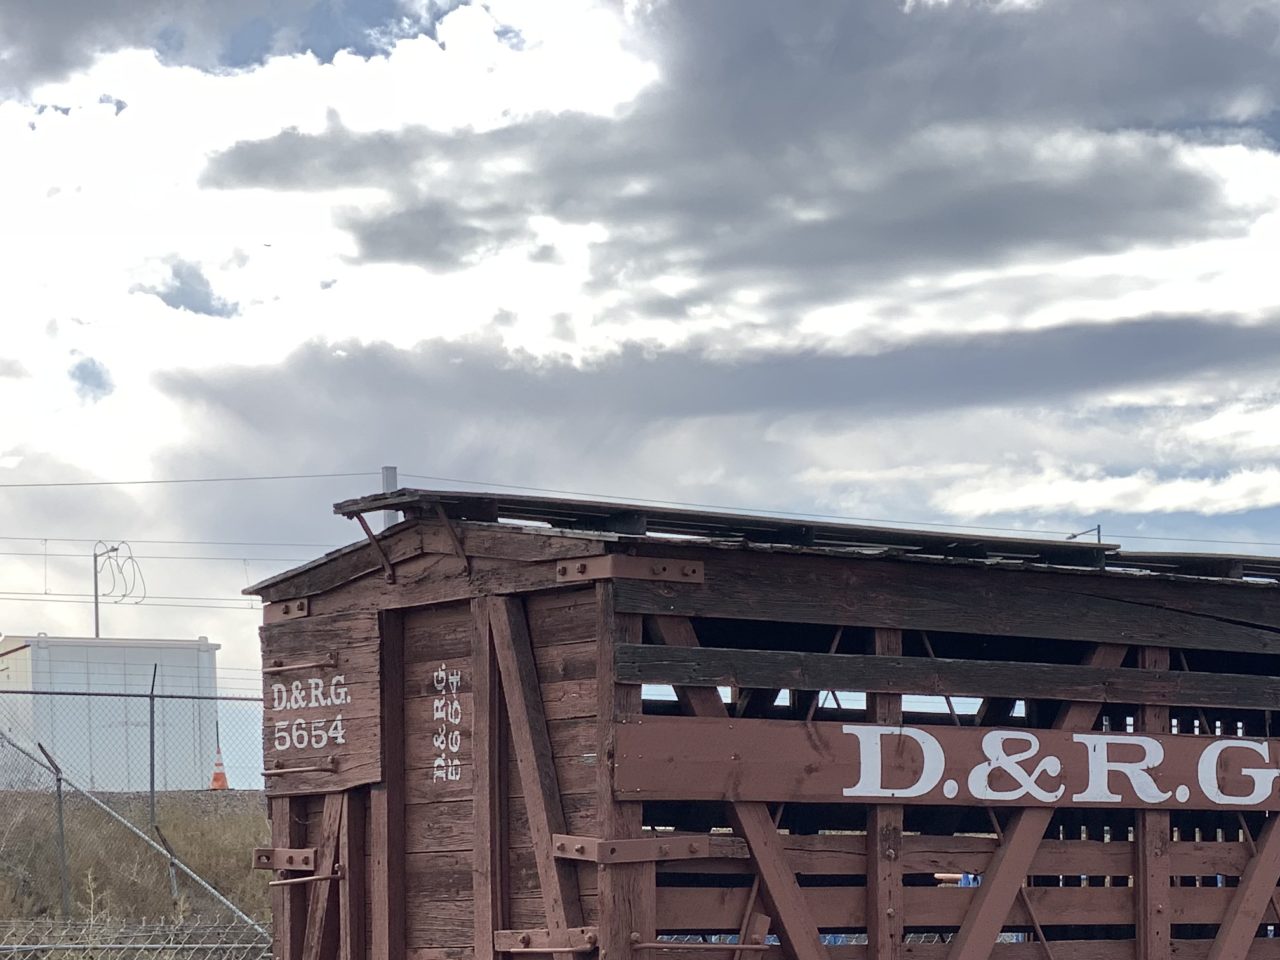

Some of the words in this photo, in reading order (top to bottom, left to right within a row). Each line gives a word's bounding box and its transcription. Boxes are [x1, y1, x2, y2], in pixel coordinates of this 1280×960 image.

[271, 675, 351, 711] D.&R.G.
[274, 714, 346, 750] 5654
[447, 670, 461, 780] 5654
